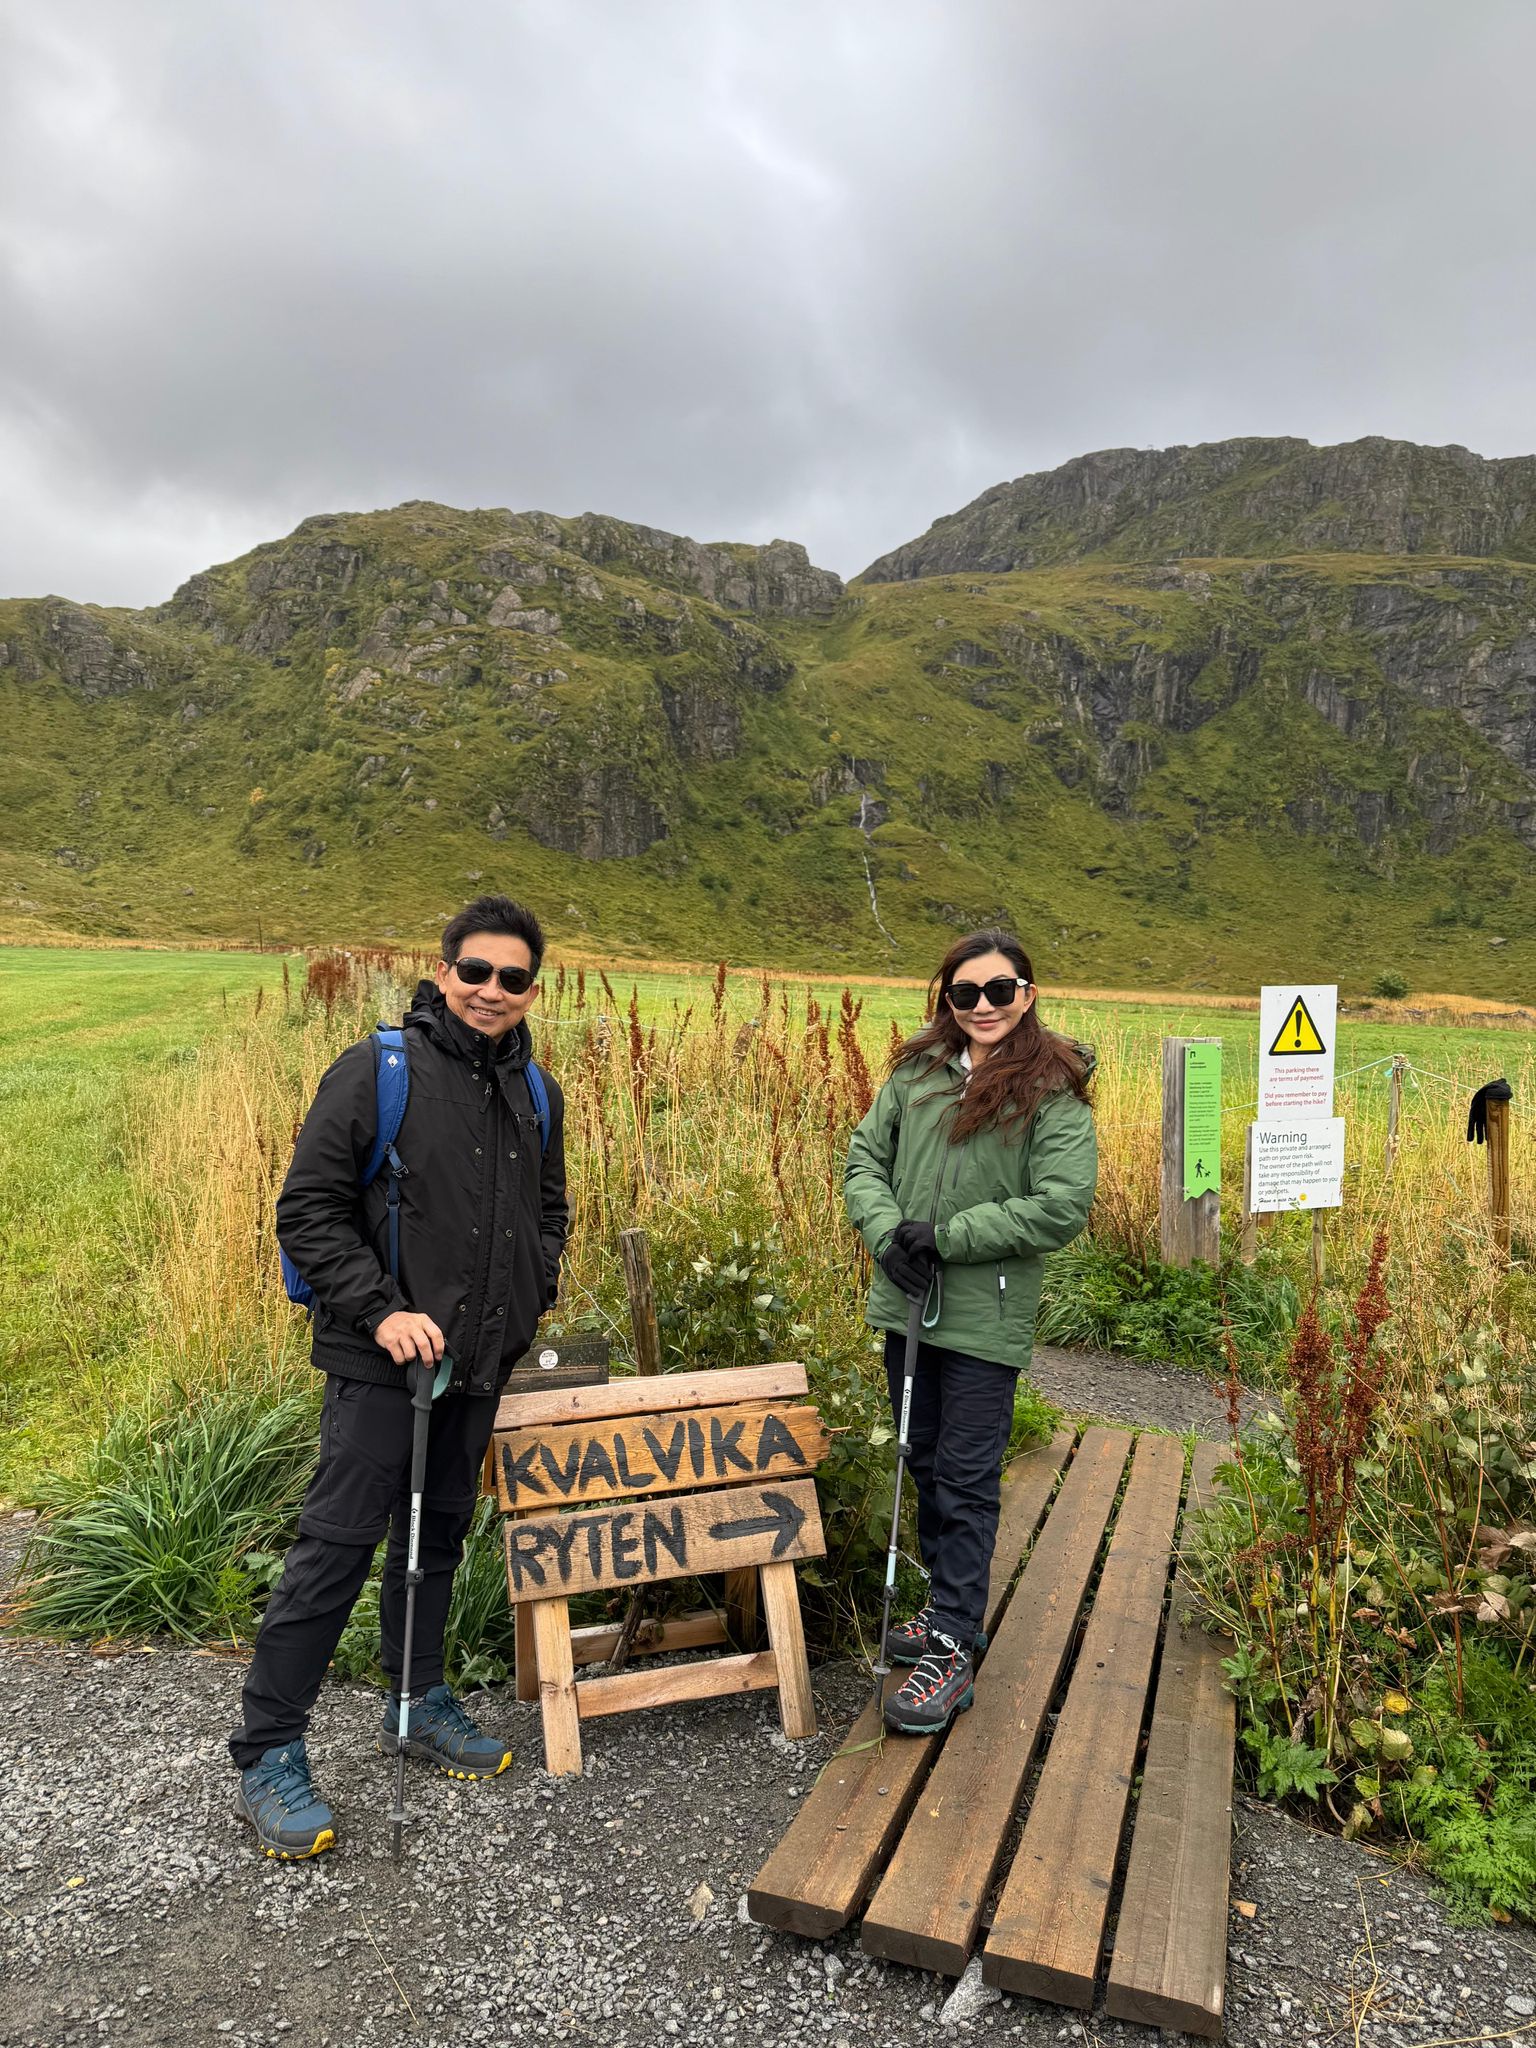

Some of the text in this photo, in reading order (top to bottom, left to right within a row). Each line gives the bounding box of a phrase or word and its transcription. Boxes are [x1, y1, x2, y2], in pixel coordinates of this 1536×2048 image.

[1260, 1131, 1307, 1145] Warning
[501, 1414, 807, 1505] KVALVIKA
[509, 1506, 688, 1592] RYTEN
